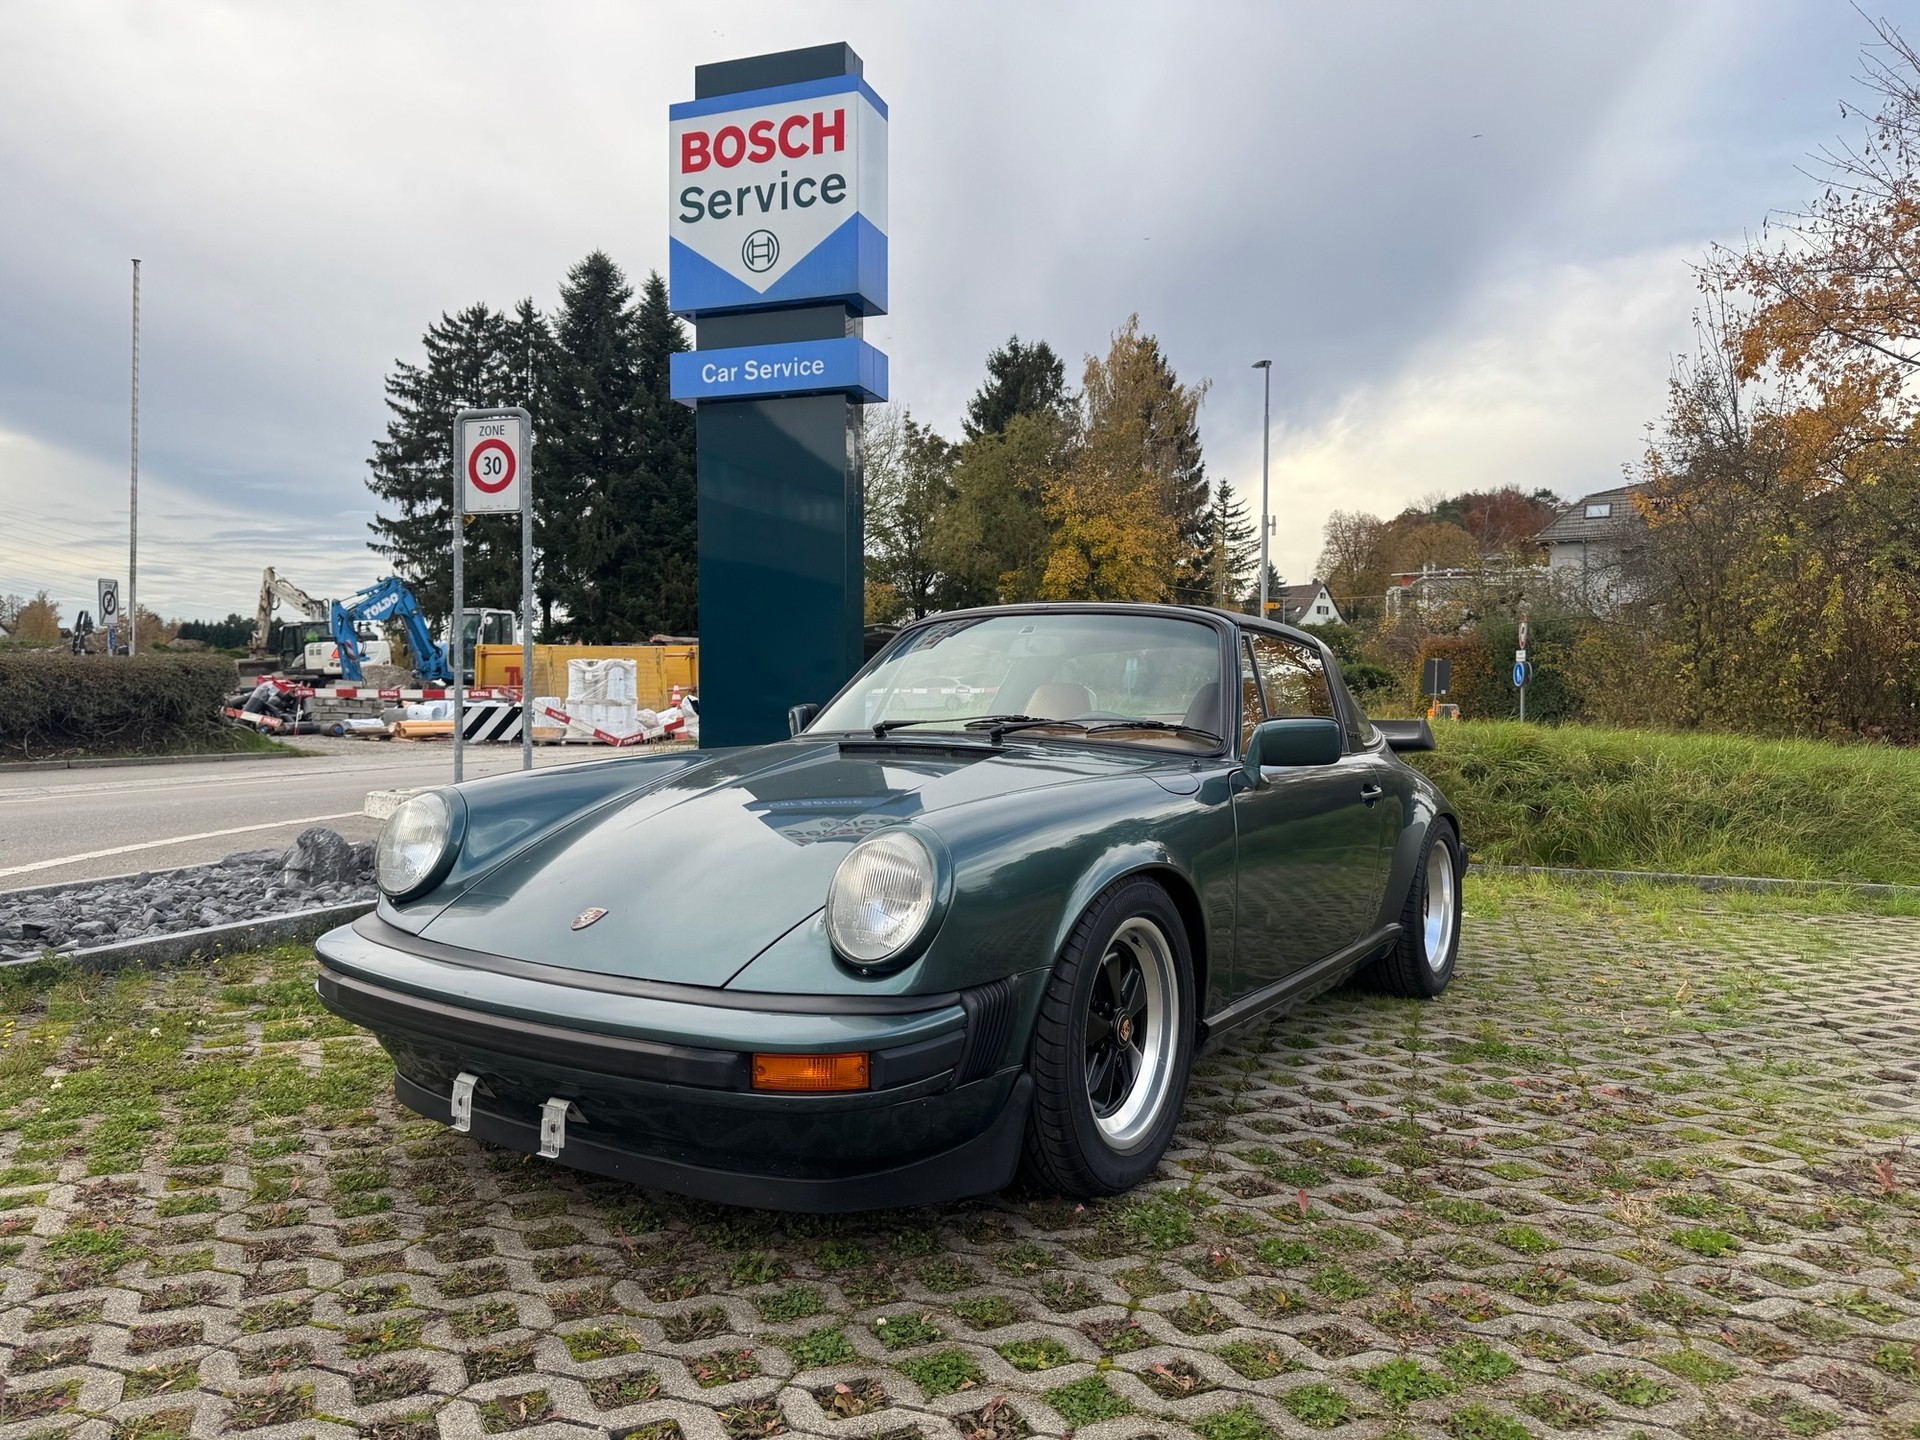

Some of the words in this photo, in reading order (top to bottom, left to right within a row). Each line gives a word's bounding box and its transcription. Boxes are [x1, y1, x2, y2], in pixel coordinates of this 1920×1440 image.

[681, 108, 845, 174] BOSCH
[678, 170, 847, 224] Service
[701, 363, 738, 384] Car
[744, 357, 825, 380] Service
[479, 425, 505, 437] ZONE
[482, 456, 502, 476] 30
[362, 592, 399, 620] TOLDO
